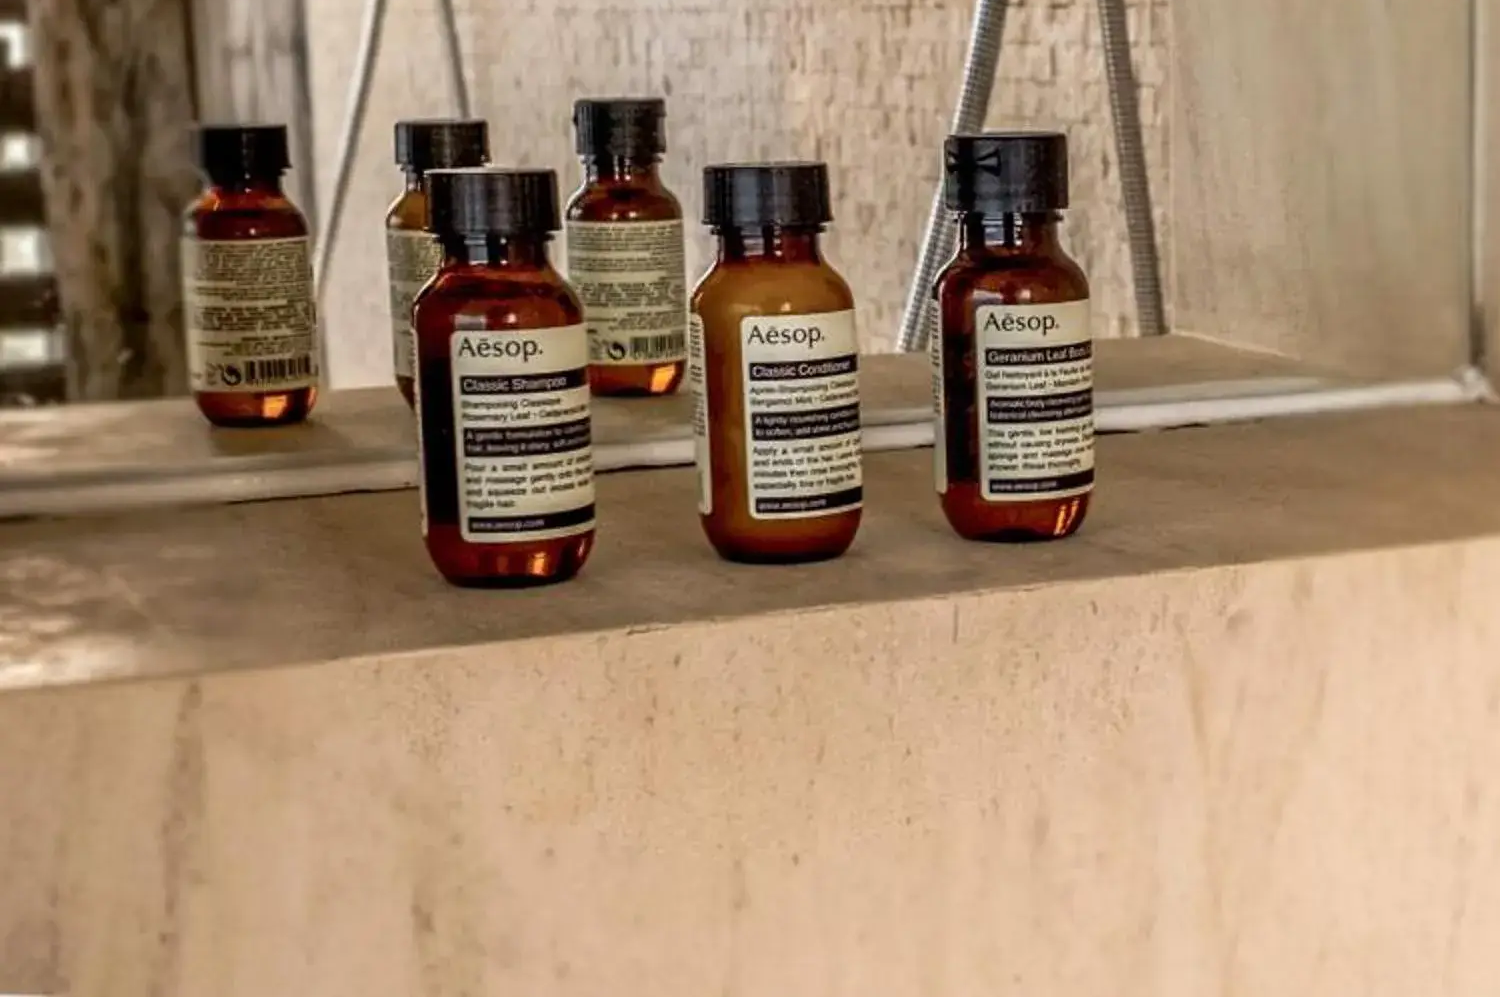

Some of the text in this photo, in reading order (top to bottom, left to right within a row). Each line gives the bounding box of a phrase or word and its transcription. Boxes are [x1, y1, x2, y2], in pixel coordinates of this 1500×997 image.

[983, 312, 1060, 337] Aēsop.
[458, 336, 544, 362] Aēsop.
[987, 349, 1045, 364] Geranium
[1046, 347, 1068, 362] Leaf
[752, 364, 797, 378] Classic
[463, 376, 567, 392] Classic Shampoo
